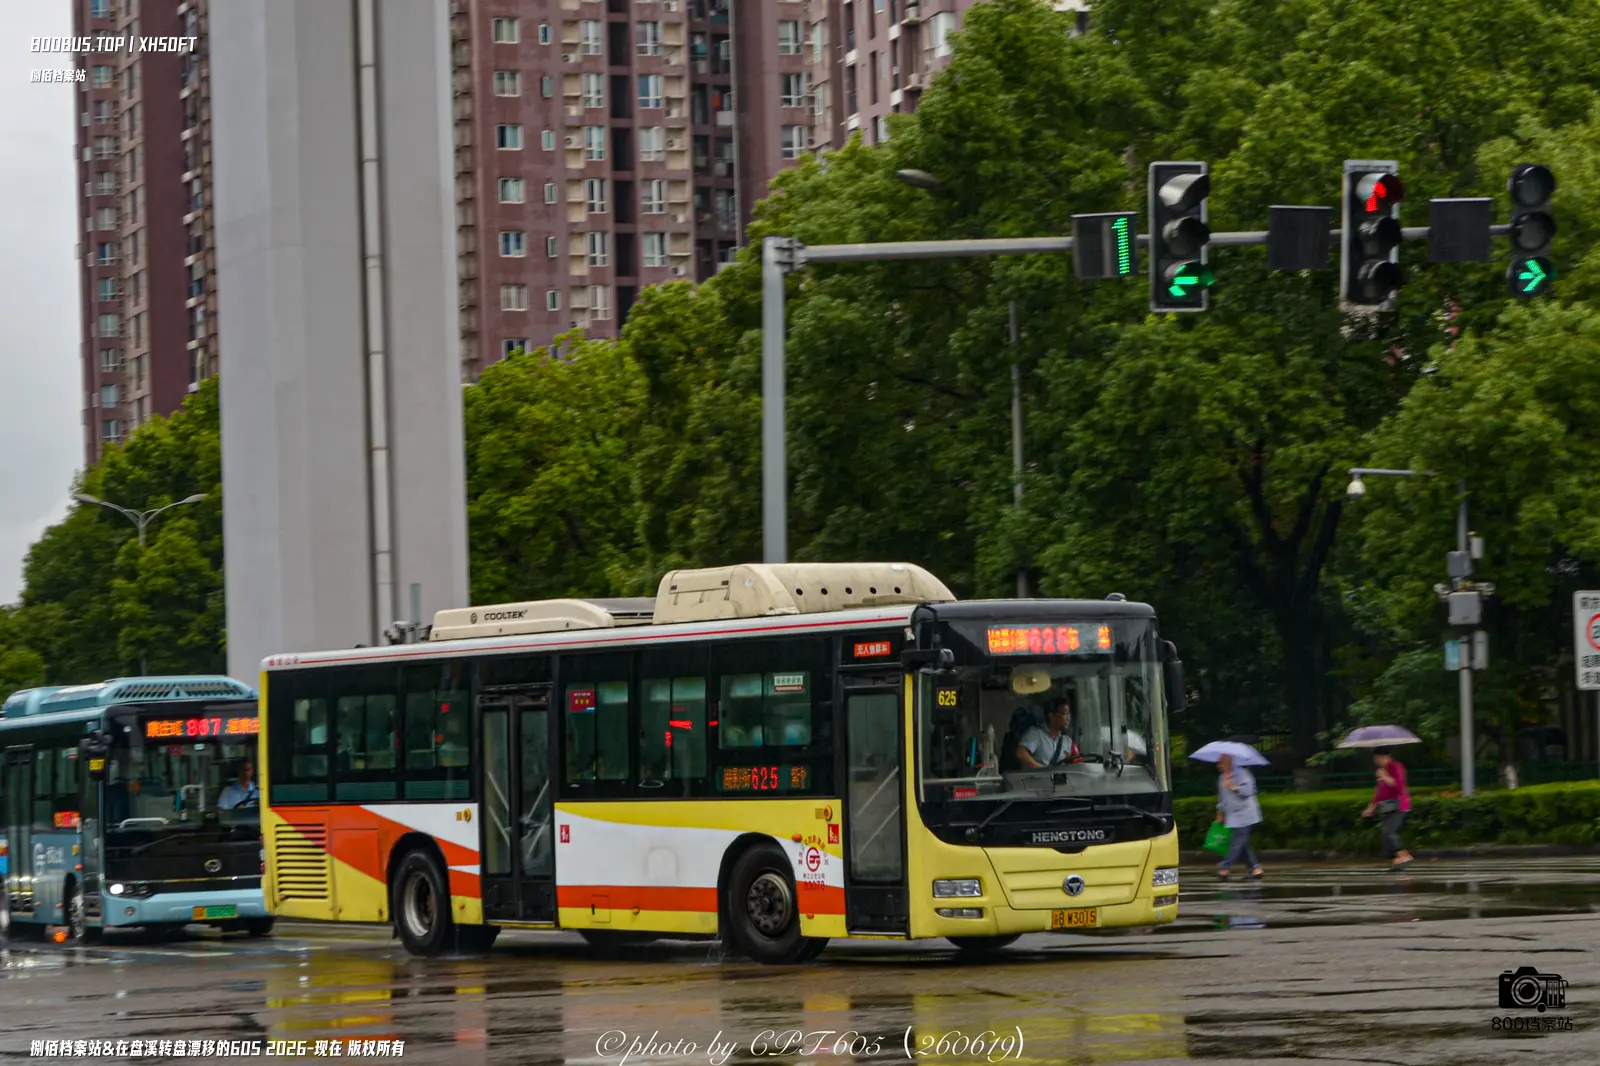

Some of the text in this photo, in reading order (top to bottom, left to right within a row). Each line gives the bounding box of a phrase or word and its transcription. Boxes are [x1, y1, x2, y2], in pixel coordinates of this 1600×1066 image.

[484, 610, 527, 621] COOLTEK
[938, 690, 957, 706] 625
[751, 766, 779, 790] 625
[1032, 829, 1105, 843] HENGTONG
